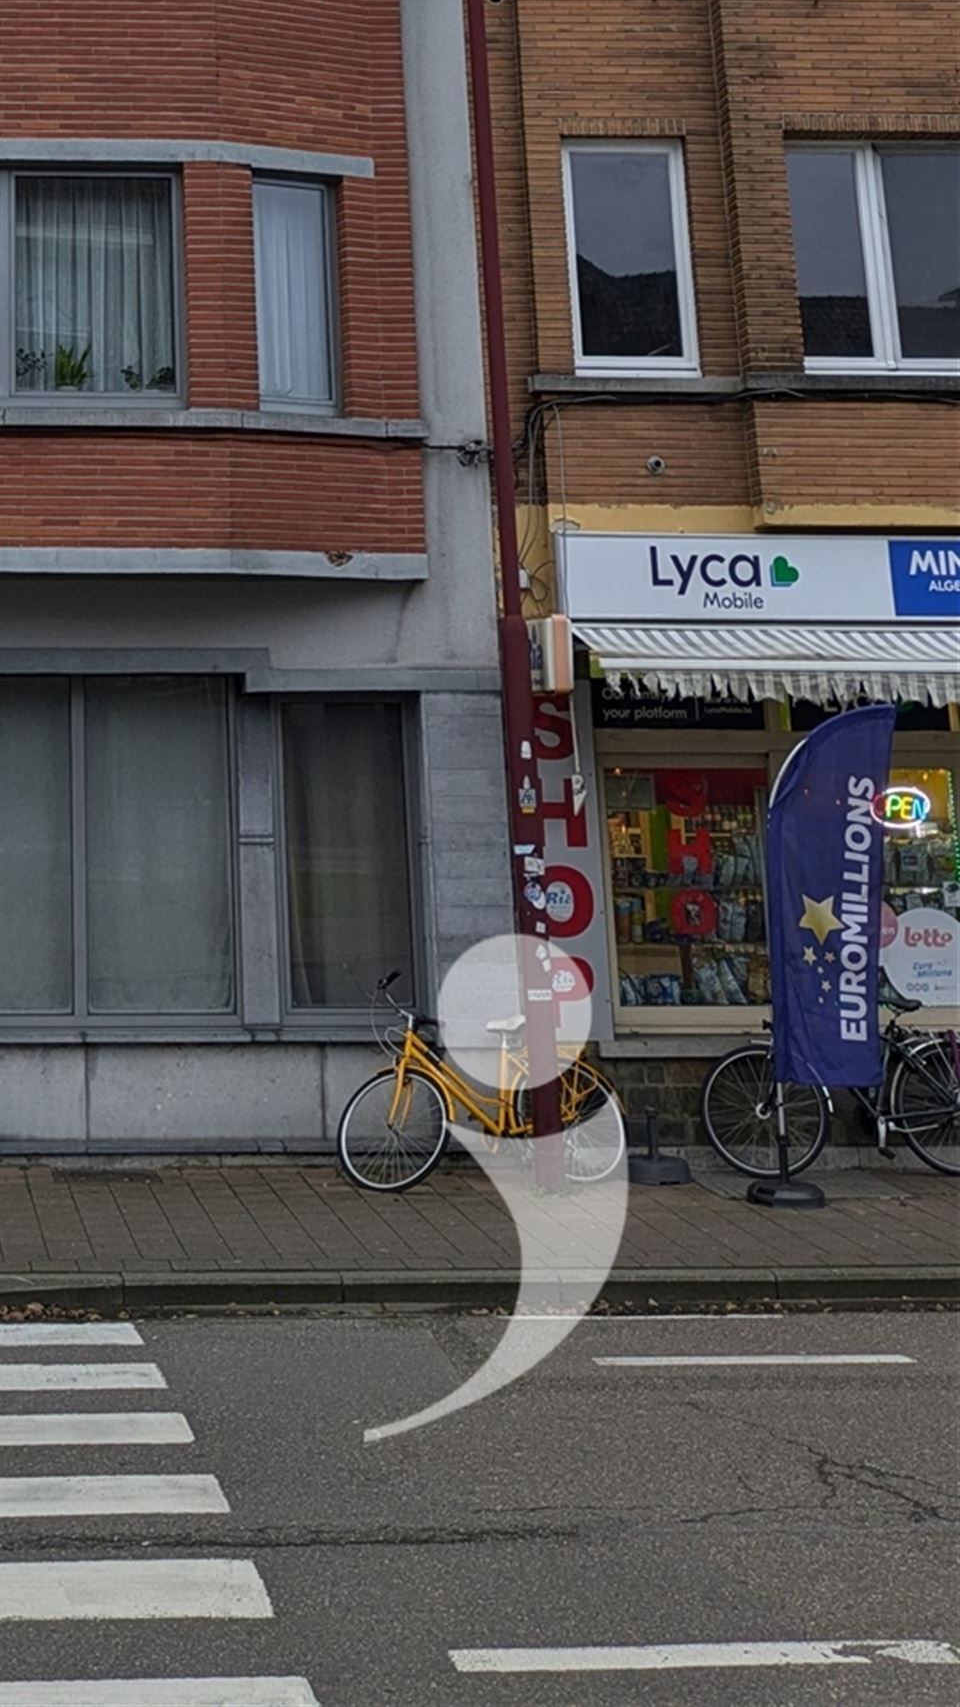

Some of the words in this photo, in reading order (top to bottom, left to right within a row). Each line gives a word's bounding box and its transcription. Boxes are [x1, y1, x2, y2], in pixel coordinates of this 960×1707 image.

[650, 546, 762, 595] Lyca
[703, 592, 764, 609] Mobile
[602, 708, 631, 721] your
[634, 706, 688, 721] platform
[873, 794, 927, 821] OPEN
[533, 692, 594, 1028] SHOP
[840, 775, 876, 1042] EUROMILLIONS
